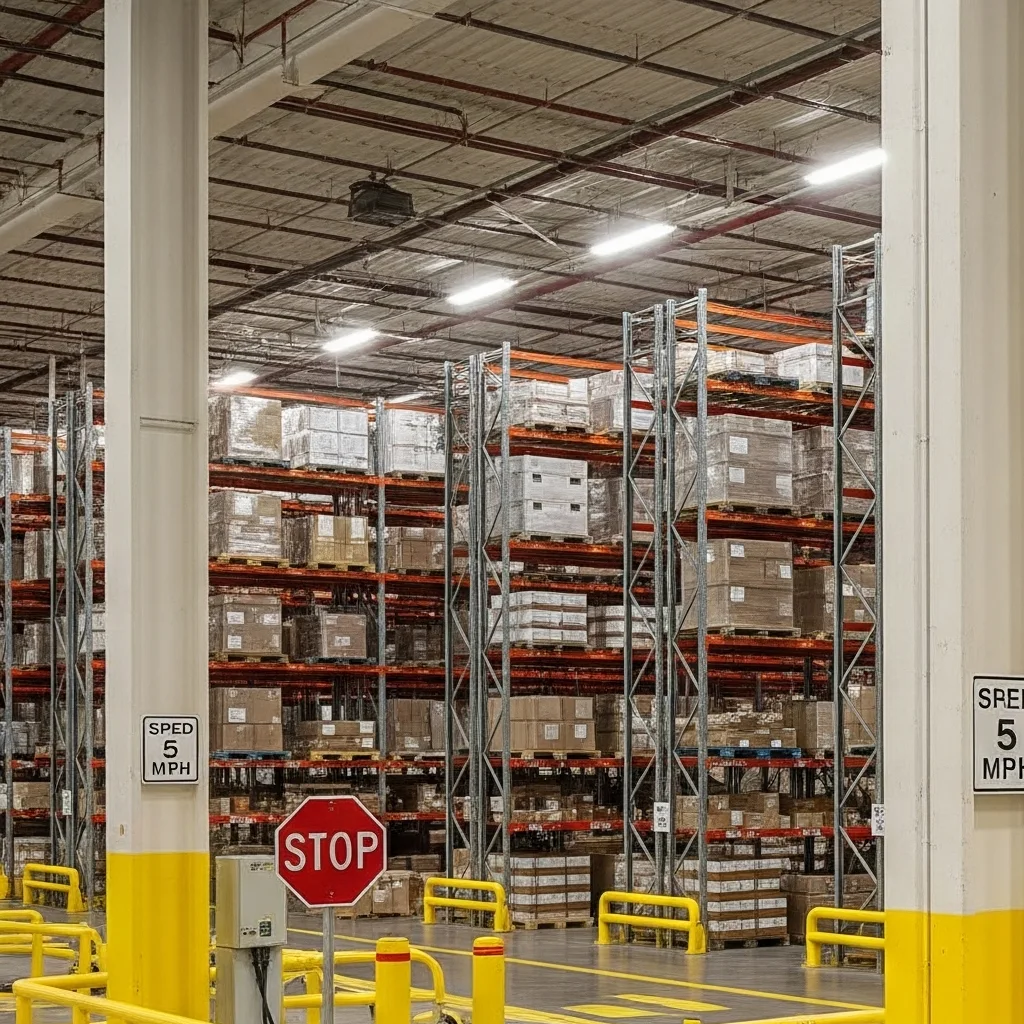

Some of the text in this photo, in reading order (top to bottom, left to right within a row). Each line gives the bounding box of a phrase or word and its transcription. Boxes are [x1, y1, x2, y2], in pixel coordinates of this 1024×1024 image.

[149, 723, 193, 735] SPED
[998, 719, 1017, 750] 5
[163, 740, 178, 758] 5
[152, 762, 190, 775] MPH
[284, 831, 378, 871] STOP
